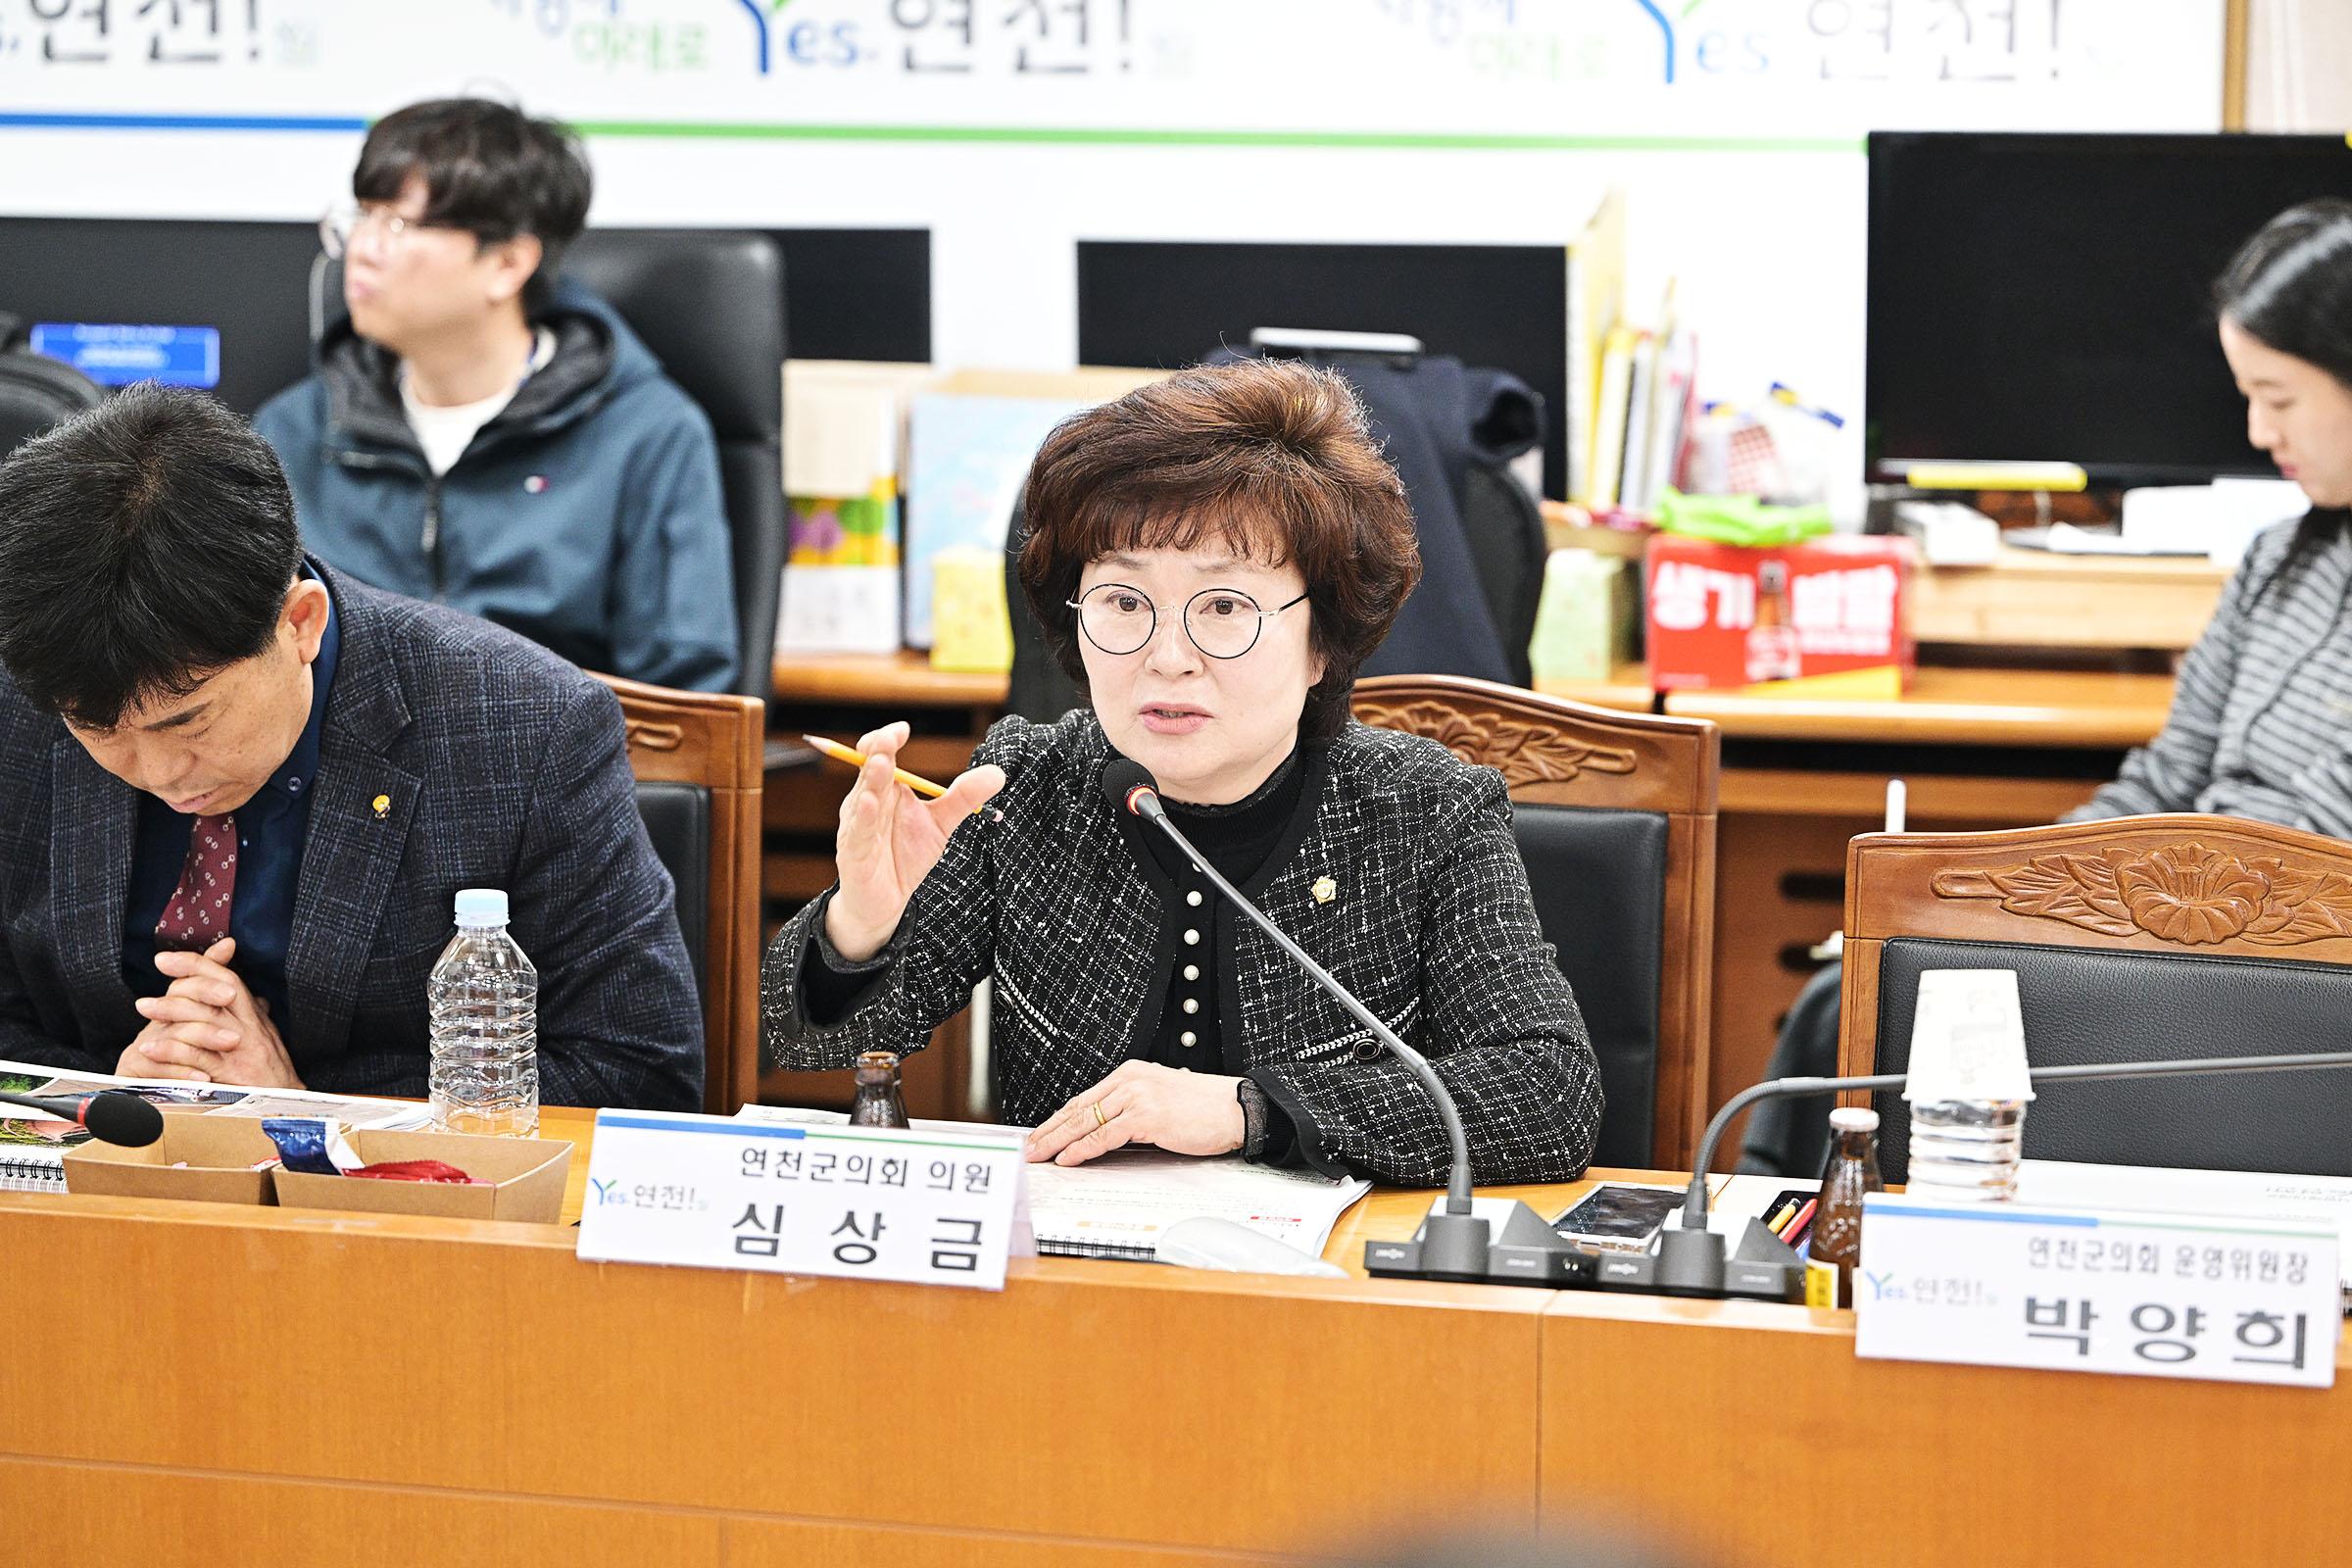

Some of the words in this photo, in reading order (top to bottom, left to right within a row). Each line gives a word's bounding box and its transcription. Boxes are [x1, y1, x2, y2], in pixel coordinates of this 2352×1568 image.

[741, 1147, 909, 1189] 연천군의회
[927, 1160, 992, 1195] 의원
[2029, 1237, 2161, 1275] 연천군의회
[2175, 1244, 2309, 1286] 운영위원장
